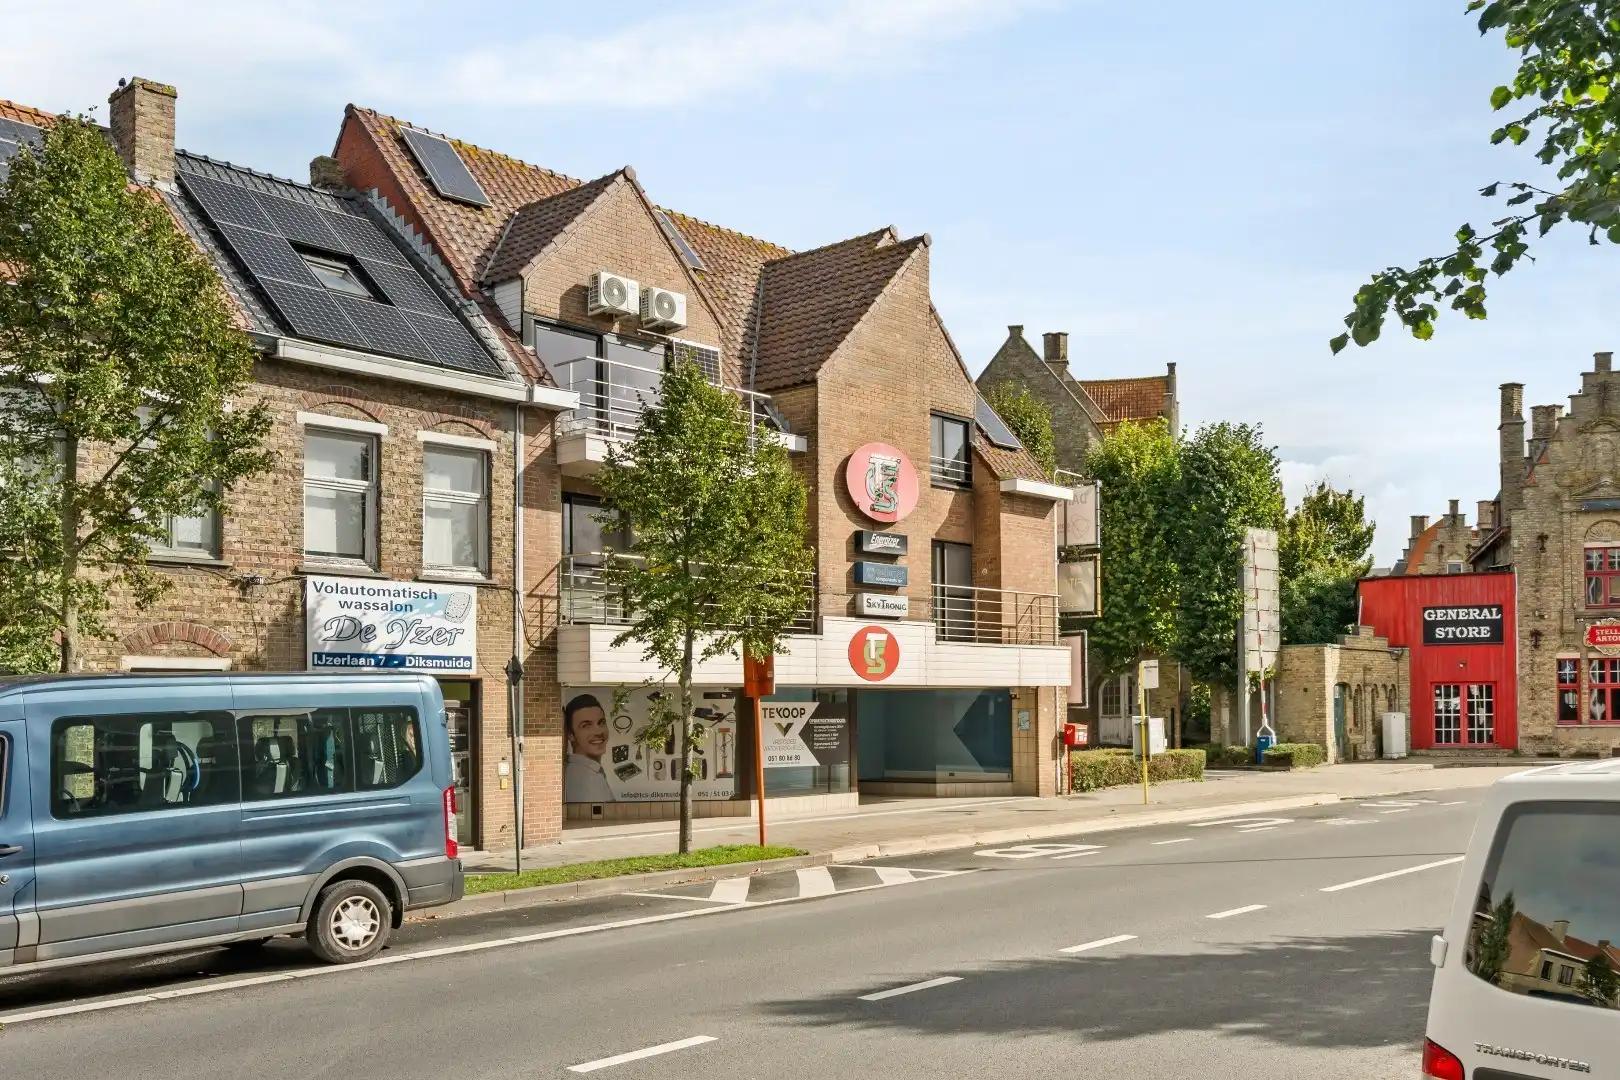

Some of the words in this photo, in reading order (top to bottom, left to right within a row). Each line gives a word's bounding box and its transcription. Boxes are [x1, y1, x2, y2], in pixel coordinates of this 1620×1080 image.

[870, 533, 900, 547] Energizer
[312, 581, 438, 600] Volautomatisch
[339, 600, 413, 612] wassalon
[1424, 608, 1501, 620] GENERAL
[322, 614, 377, 643] De
[385, 618, 464, 650] Yzer
[1435, 626, 1490, 638] STORE
[313, 654, 374, 666] IJzerlaan
[378, 656, 386, 666] 7
[405, 656, 471, 668] Diksmuide
[1473, 1040, 1591, 1073] TRANSPORTER
